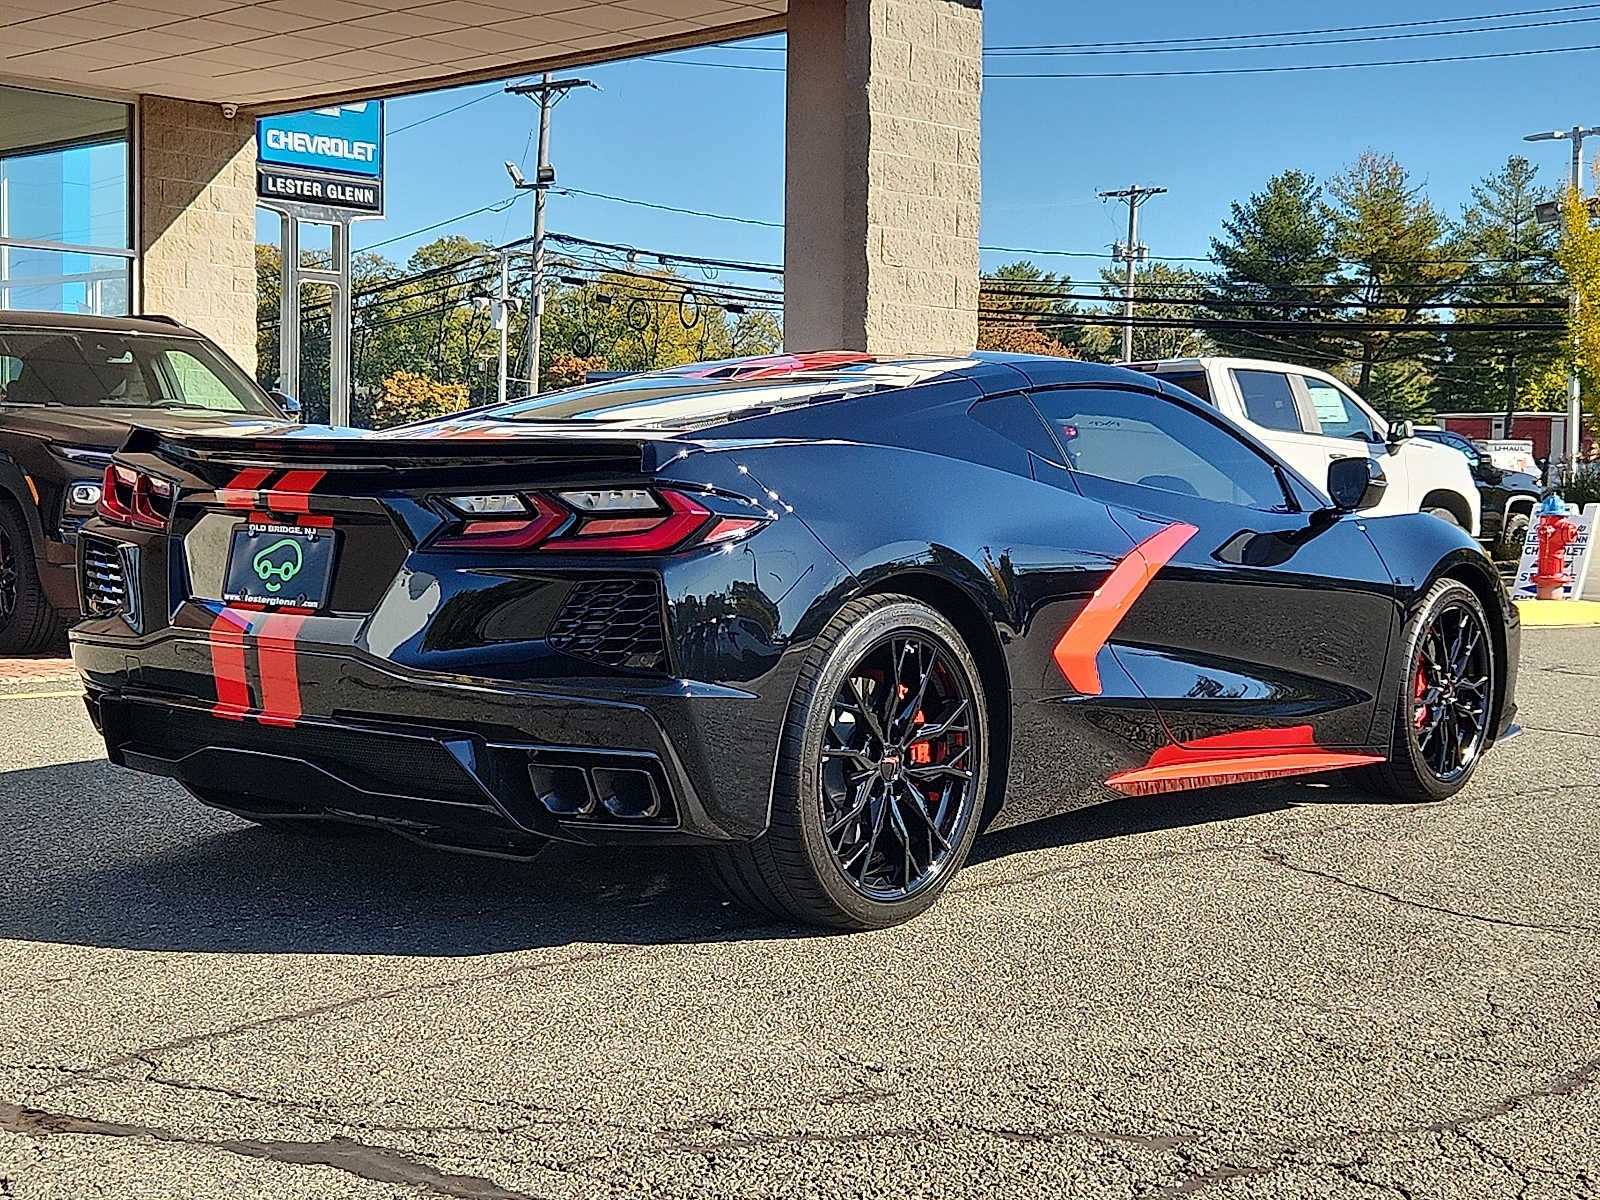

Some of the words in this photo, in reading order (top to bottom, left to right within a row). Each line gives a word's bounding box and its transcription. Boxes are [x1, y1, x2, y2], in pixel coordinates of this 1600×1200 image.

[266, 128, 377, 162] CHEVROLET
[267, 177, 322, 197] LESTER
[326, 184, 374, 203] GLENN
[248, 523, 267, 532] OLD
[1524, 546, 1586, 556] CHLET
